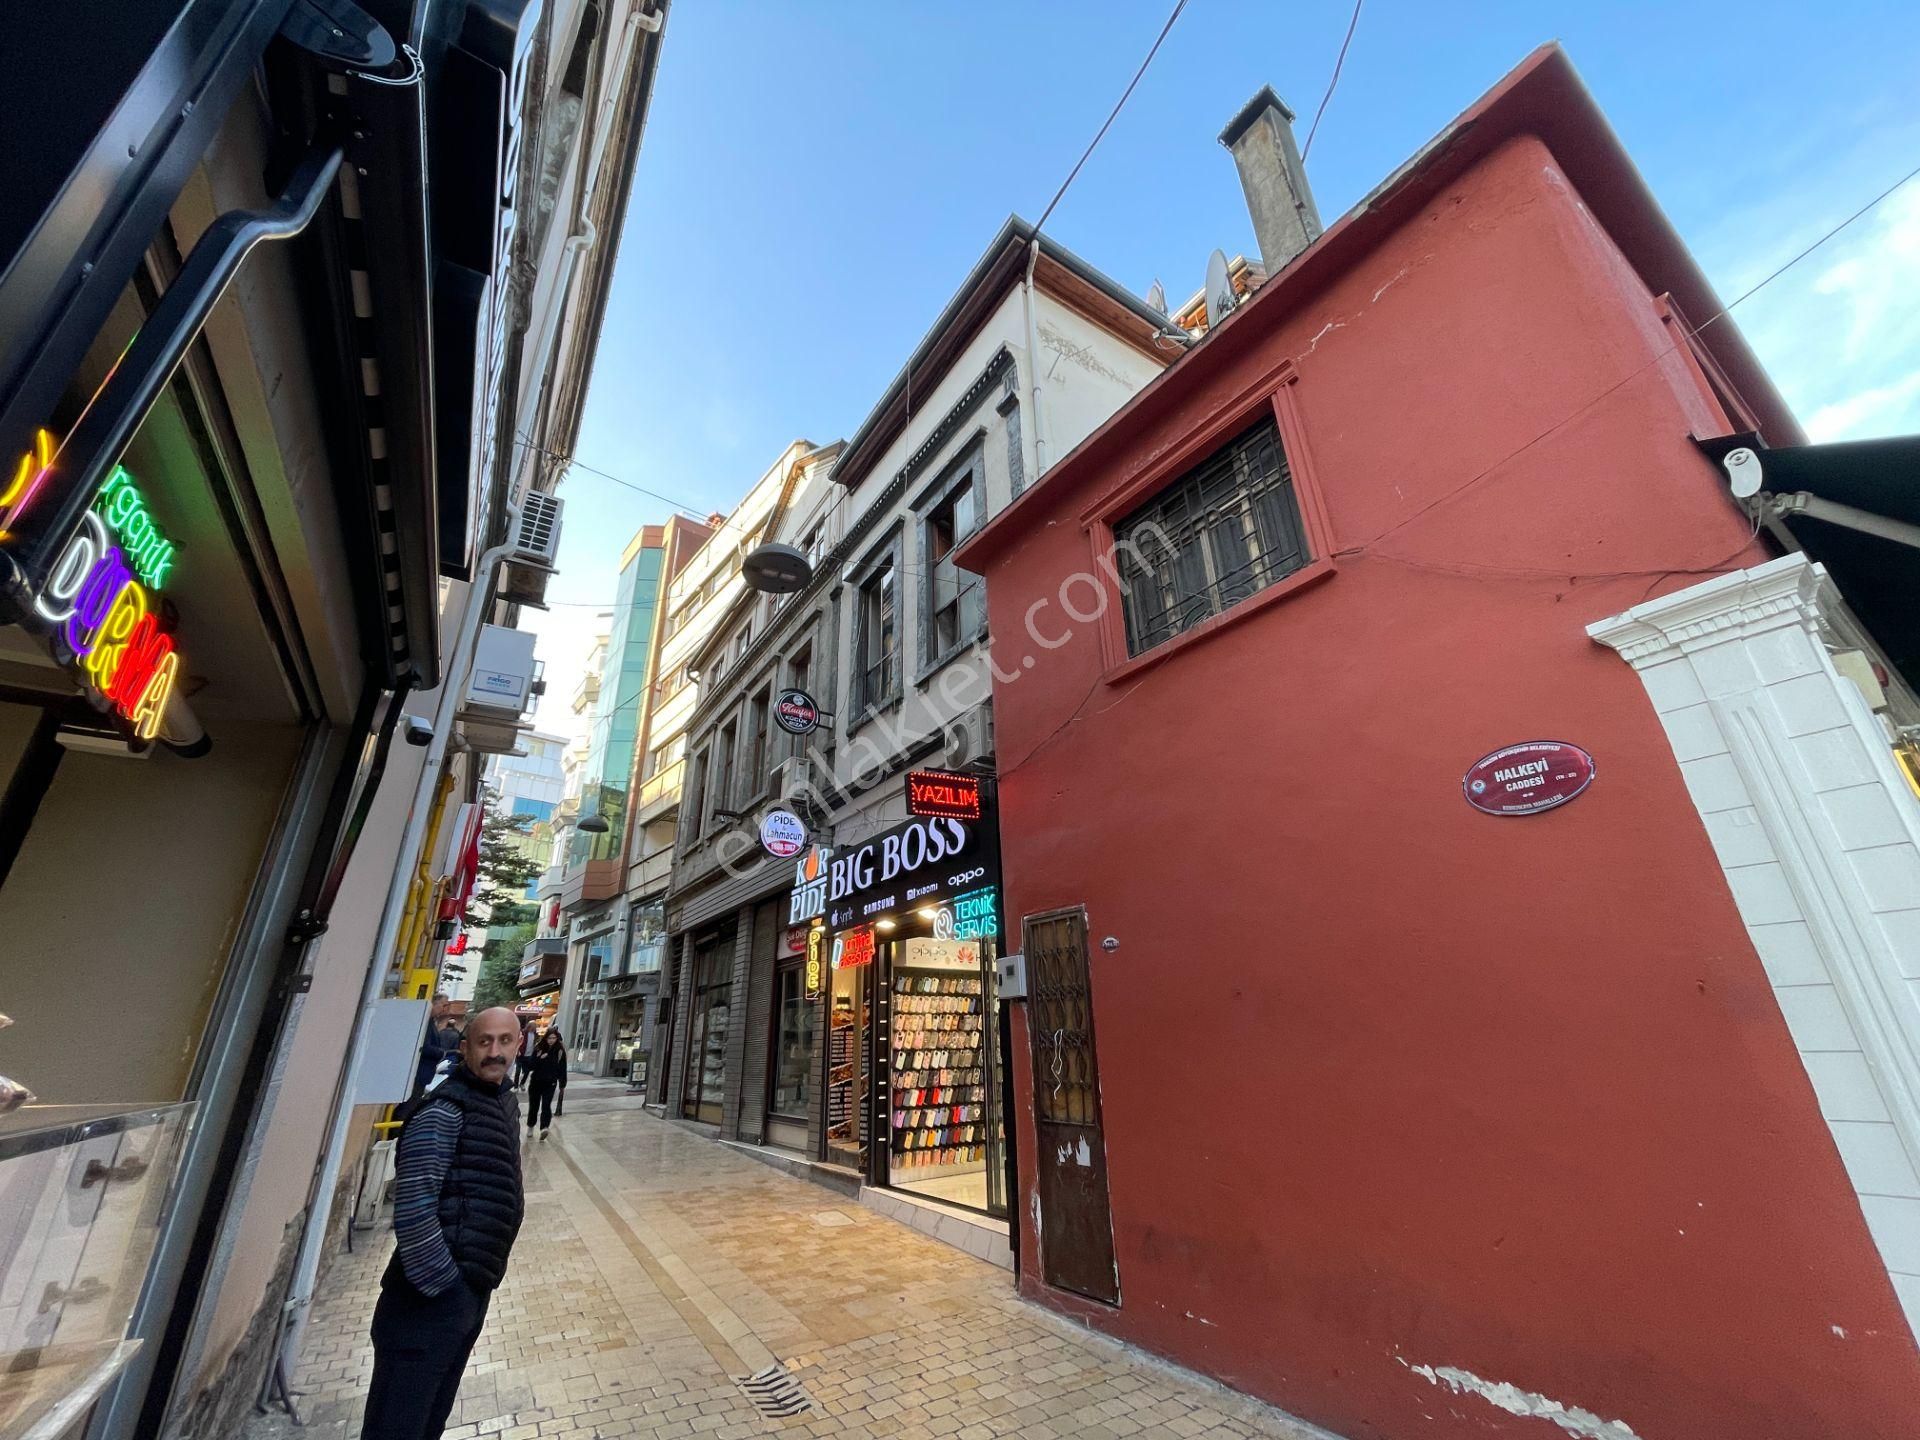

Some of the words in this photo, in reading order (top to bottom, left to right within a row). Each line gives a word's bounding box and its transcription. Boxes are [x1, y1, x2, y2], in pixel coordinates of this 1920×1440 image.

[1494, 757, 1549, 783] HALKEVİ
[1506, 774, 1545, 792] CADDESİ
[911, 782, 977, 807] YAZILIM
[766, 828, 802, 841] Lahmacun
[829, 845, 875, 902] BIG
[880, 816, 966, 882] BOSS
[947, 866, 985, 886] oppo
[863, 895, 895, 915] SAMSUNG
